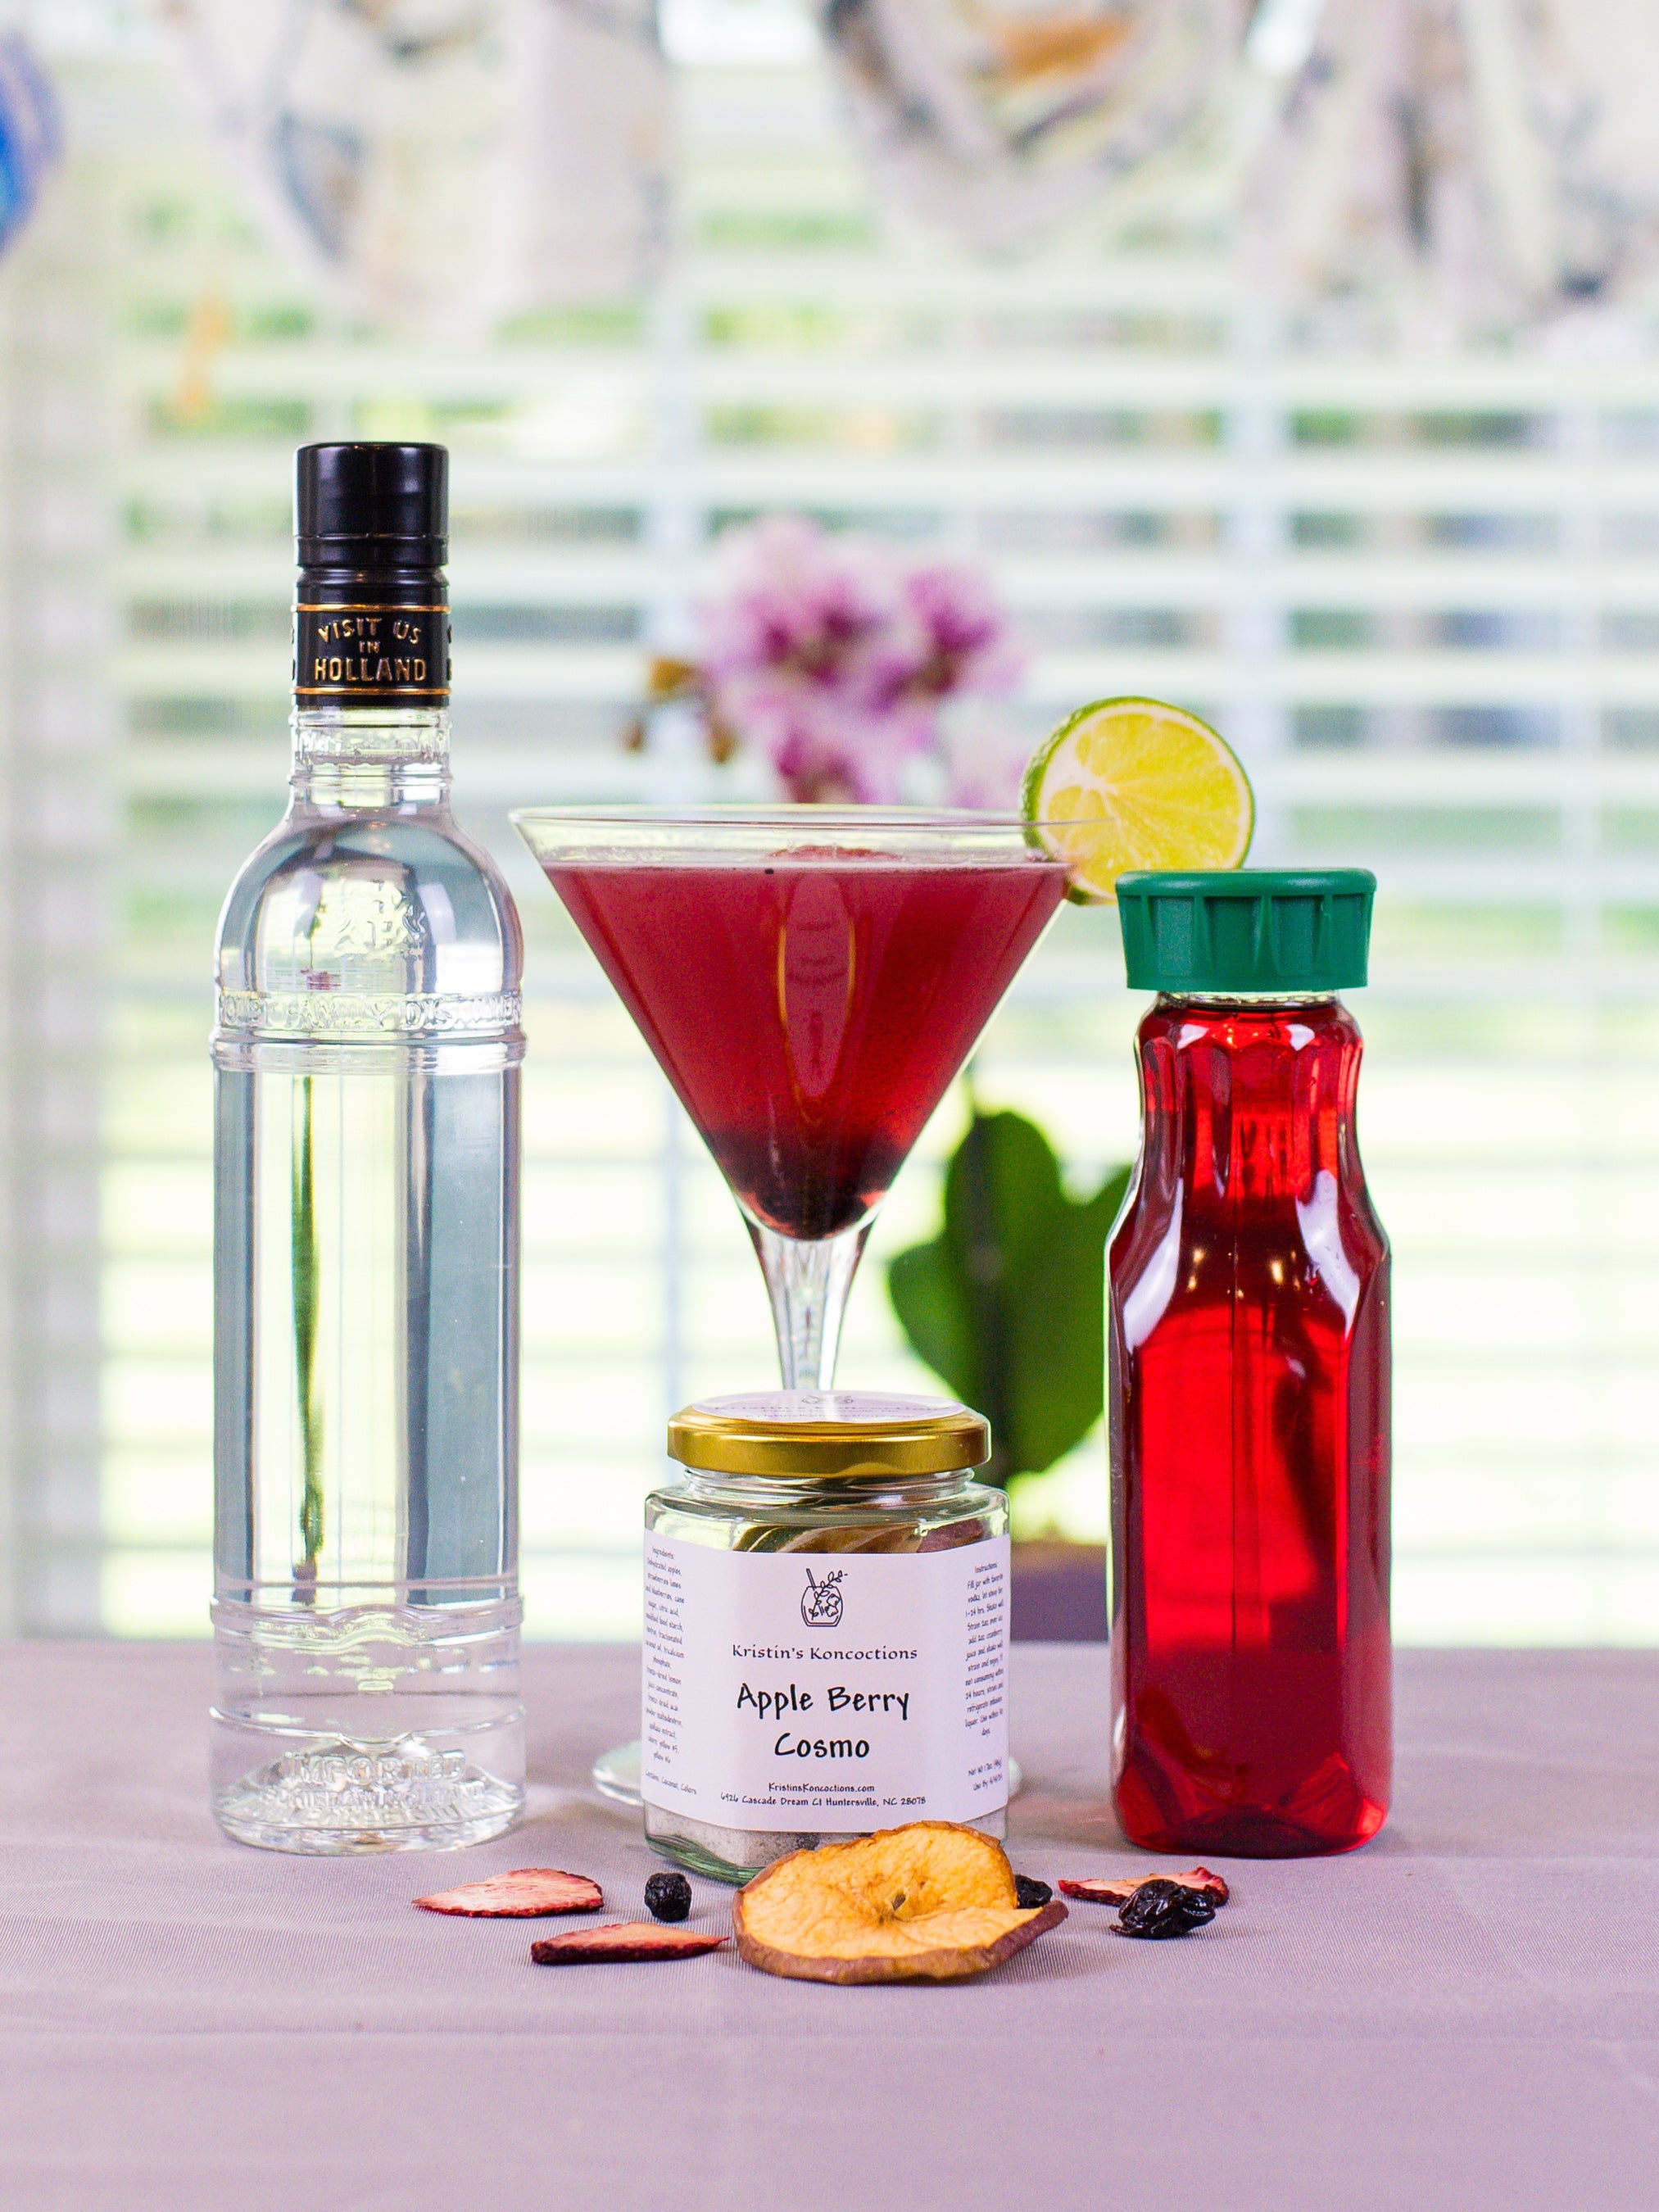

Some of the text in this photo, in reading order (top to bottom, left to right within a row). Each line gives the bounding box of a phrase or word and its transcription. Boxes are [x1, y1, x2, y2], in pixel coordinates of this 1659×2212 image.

[318, 618, 421, 645] VISIT US
[359, 641, 380, 653] IN
[315, 657, 426, 681] HOLLAND
[732, 1644, 918, 1660] Kristin's Koncoctions
[737, 1683, 909, 1720] Apple Berry
[774, 1733, 870, 1758] Cosmo
[768, 1782, 875, 1793] KristinsKoncoctions.com
[741, 1795, 777, 1805] Cascade
[781, 1797, 809, 1806] Dream
[826, 1797, 879, 1806] Huntersville,
[882, 1797, 898, 1806] NC
[901, 1796, 926, 1805] 28078
